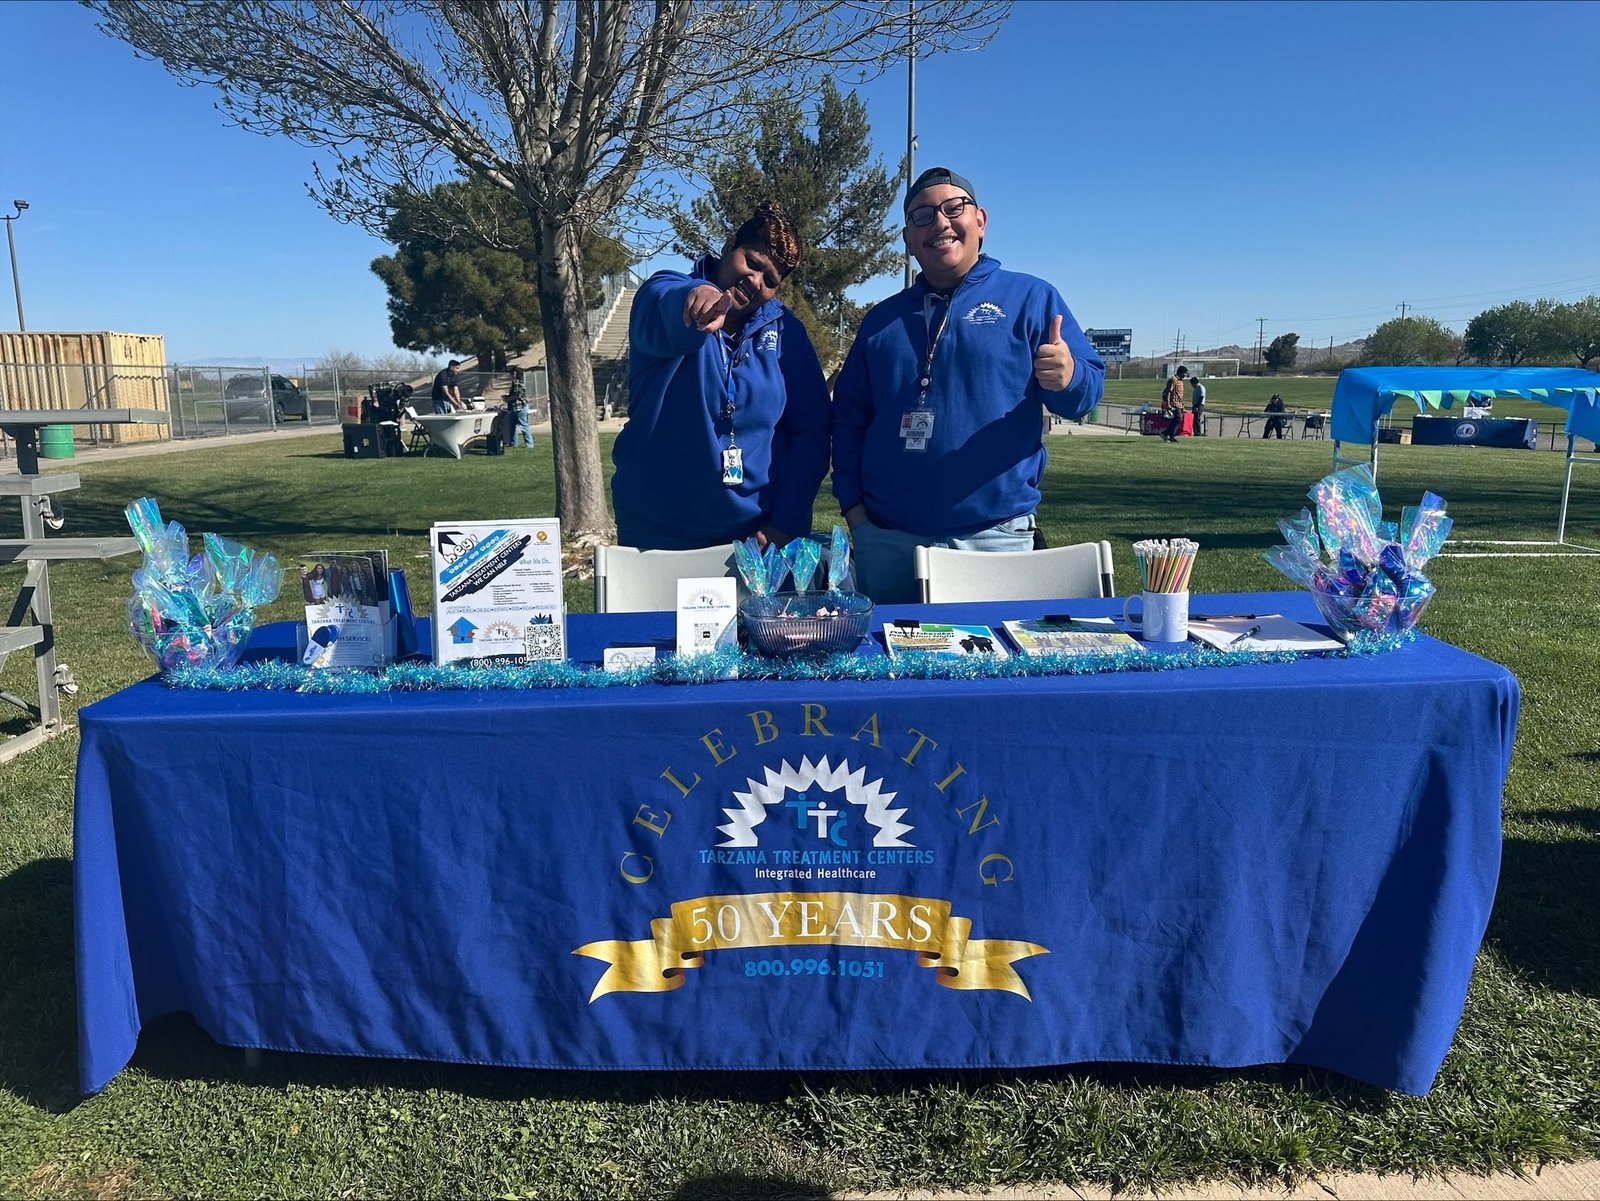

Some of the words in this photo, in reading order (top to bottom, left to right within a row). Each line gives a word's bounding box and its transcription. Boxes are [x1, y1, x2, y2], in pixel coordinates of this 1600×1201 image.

[443, 534, 480, 564] hey!
[448, 579, 473, 598] TARZANA
[472, 556, 500, 580] TREATMENT
[500, 540, 522, 558] CENTERS
[472, 578, 483, 586] WE
[482, 568, 496, 579] CAN
[495, 559, 507, 570] HELP
[470, 658, 493, 668] (800)
[495, 656, 528, 666] 996-105
[620, 703, 1014, 888] CELEBRATING
[785, 792, 848, 847] TTC
[699, 849, 768, 865] TARZANA
[773, 849, 861, 865] TREATMENT
[867, 849, 935, 865] CENTERS
[755, 868, 812, 880] Integrated
[817, 868, 876, 879] Healthcare
[691, 905, 742, 943] 50
[757, 900, 932, 943] YEARS
[744, 959, 884, 978] 800.996.1051
